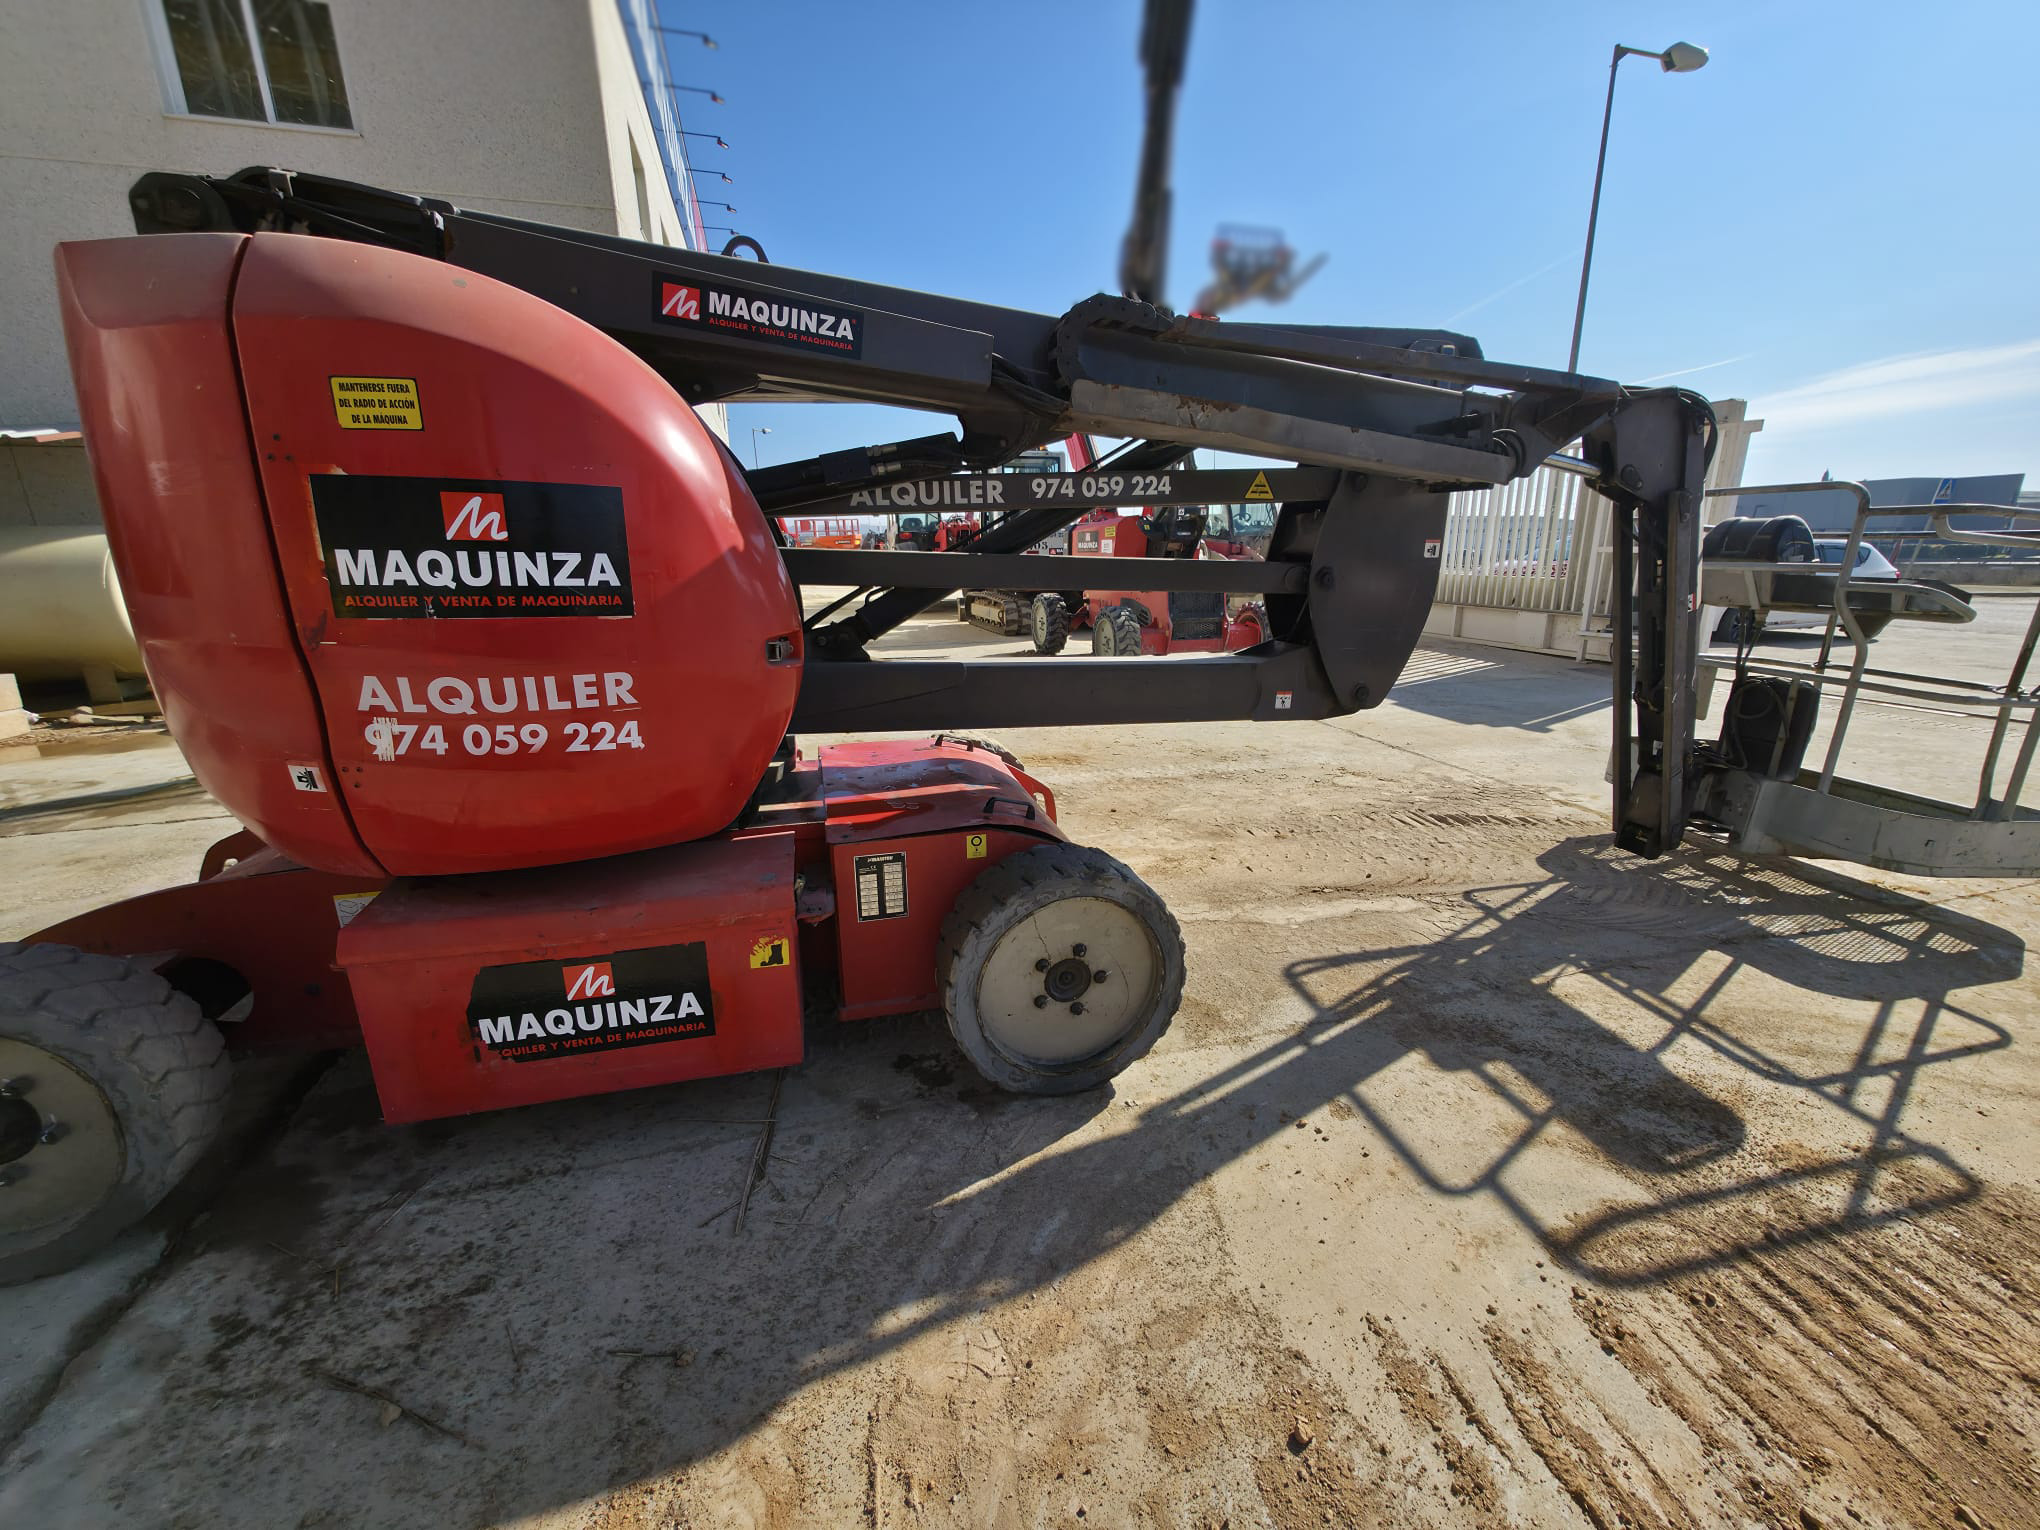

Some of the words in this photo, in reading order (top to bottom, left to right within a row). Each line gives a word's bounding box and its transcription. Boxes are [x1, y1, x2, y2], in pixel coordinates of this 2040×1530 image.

[709, 291, 854, 341] MAQUINZA
[709, 318, 748, 331] ALQUILER
[751, 324, 756, 332] Y
[760, 327, 785, 337] VENTA
[788, 332, 798, 341] DE
[800, 335, 853, 351] MAQUINARIA
[338, 382, 385, 393] MANTENERSE
[386, 383, 410, 394] FUERA
[339, 398, 352, 408] DEL
[353, 398, 376, 409] RADIO
[377, 400, 387, 409] DE
[389, 397, 416, 409] ACCIÓN
[351, 414, 361, 424] DE
[362, 415, 372, 424] LA
[850, 480, 1005, 506] ALQUILER
[1031, 478, 1075, 498] 974
[1082, 476, 1124, 497] 059
[1131, 475, 1171, 496] 224
[334, 549, 621, 589] MAQUINZA
[345, 595, 418, 607] ALQUILER
[424, 596, 434, 607] Y
[439, 595, 492, 607] VENTA
[497, 595, 516, 607] DE
[522, 595, 623, 607] MAQUINARIA
[357, 671, 640, 715] ALQUILER
[462, 723, 549, 756] 059
[564, 720, 645, 752] 224
[478, 992, 705, 1045] MAQUINZA
[502, 1043, 547, 1057] QUILER
[550, 1041, 559, 1050] Y
[563, 1036, 604, 1049] VENTA
[607, 1033, 622, 1043] DE
[626, 1021, 707, 1040] MAQUINARIA
